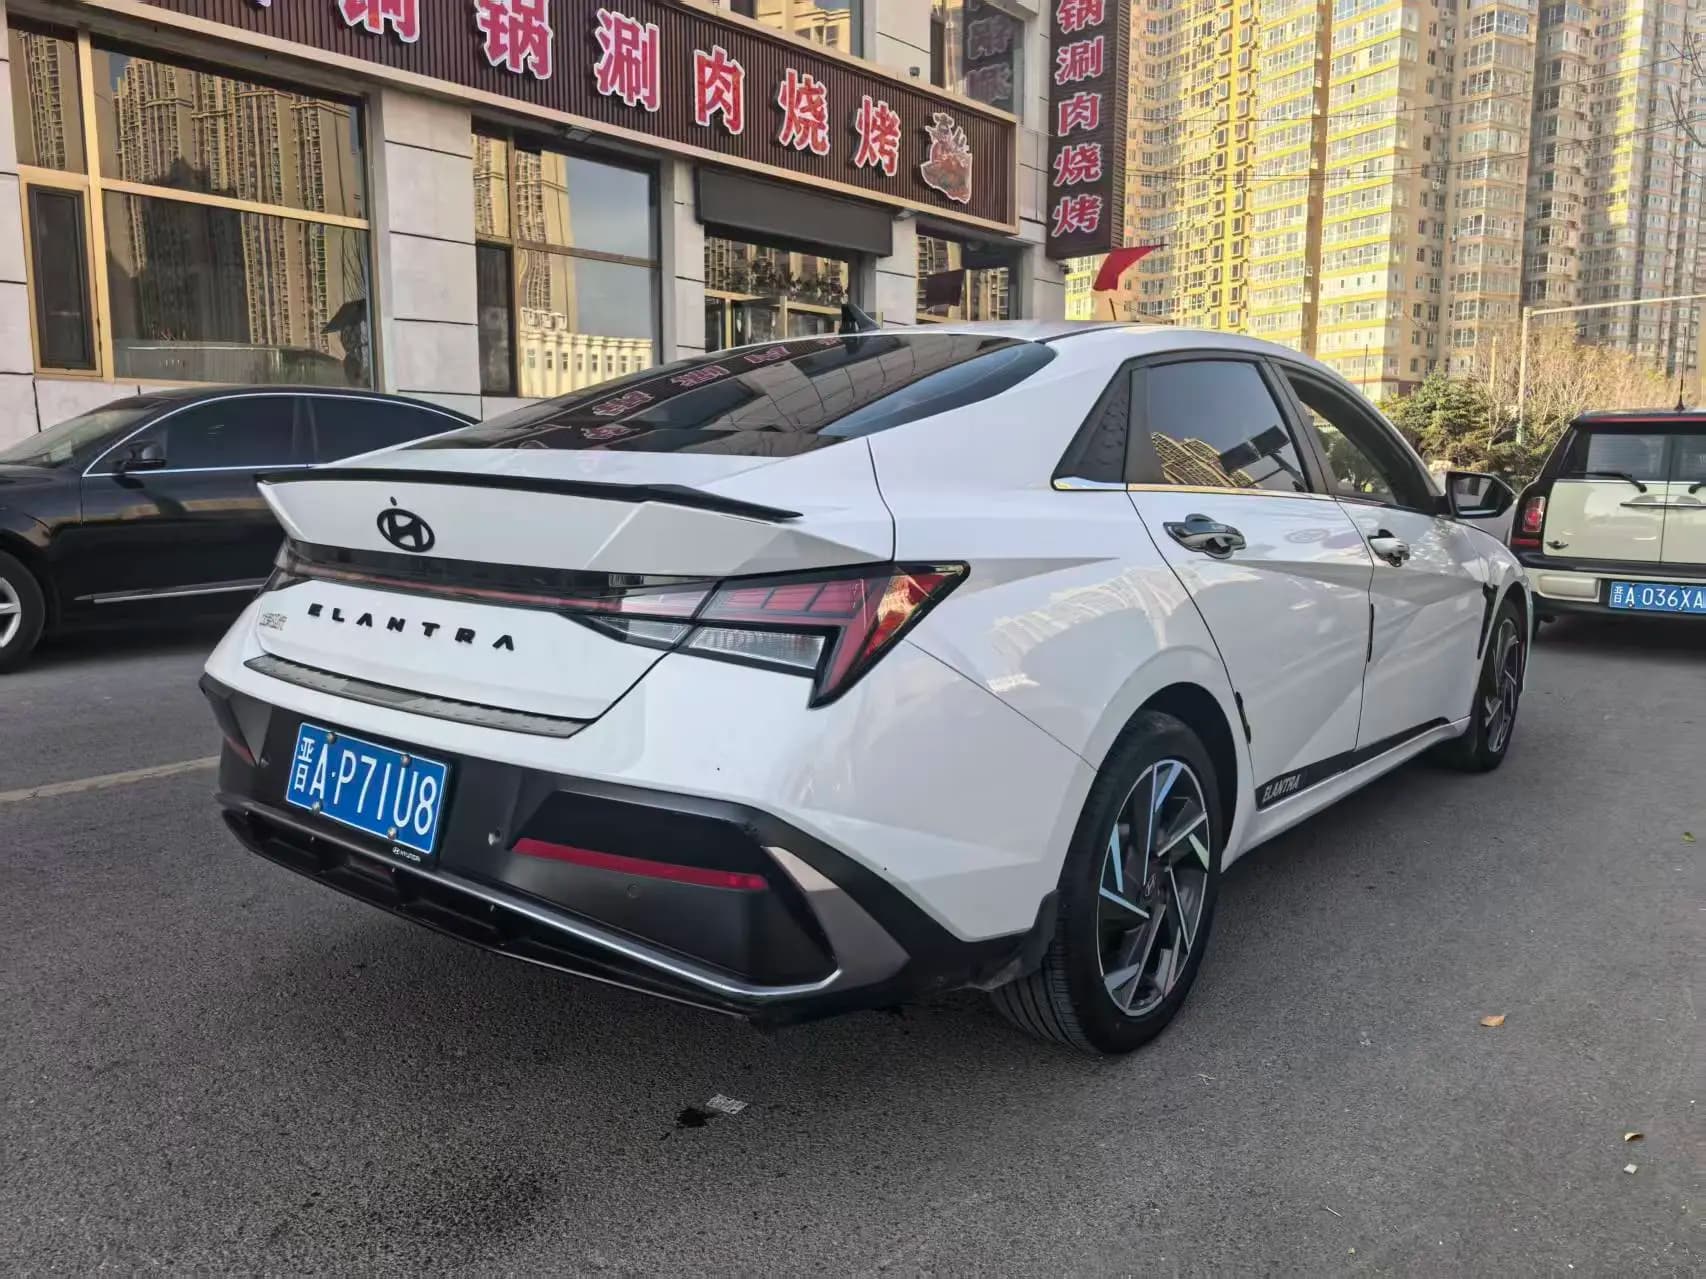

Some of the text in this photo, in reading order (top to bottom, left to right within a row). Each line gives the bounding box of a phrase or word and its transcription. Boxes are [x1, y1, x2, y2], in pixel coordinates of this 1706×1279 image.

[1052, 0, 1104, 237] 锅涮肉烧烤
[307, 603, 514, 651] ELANTRA
